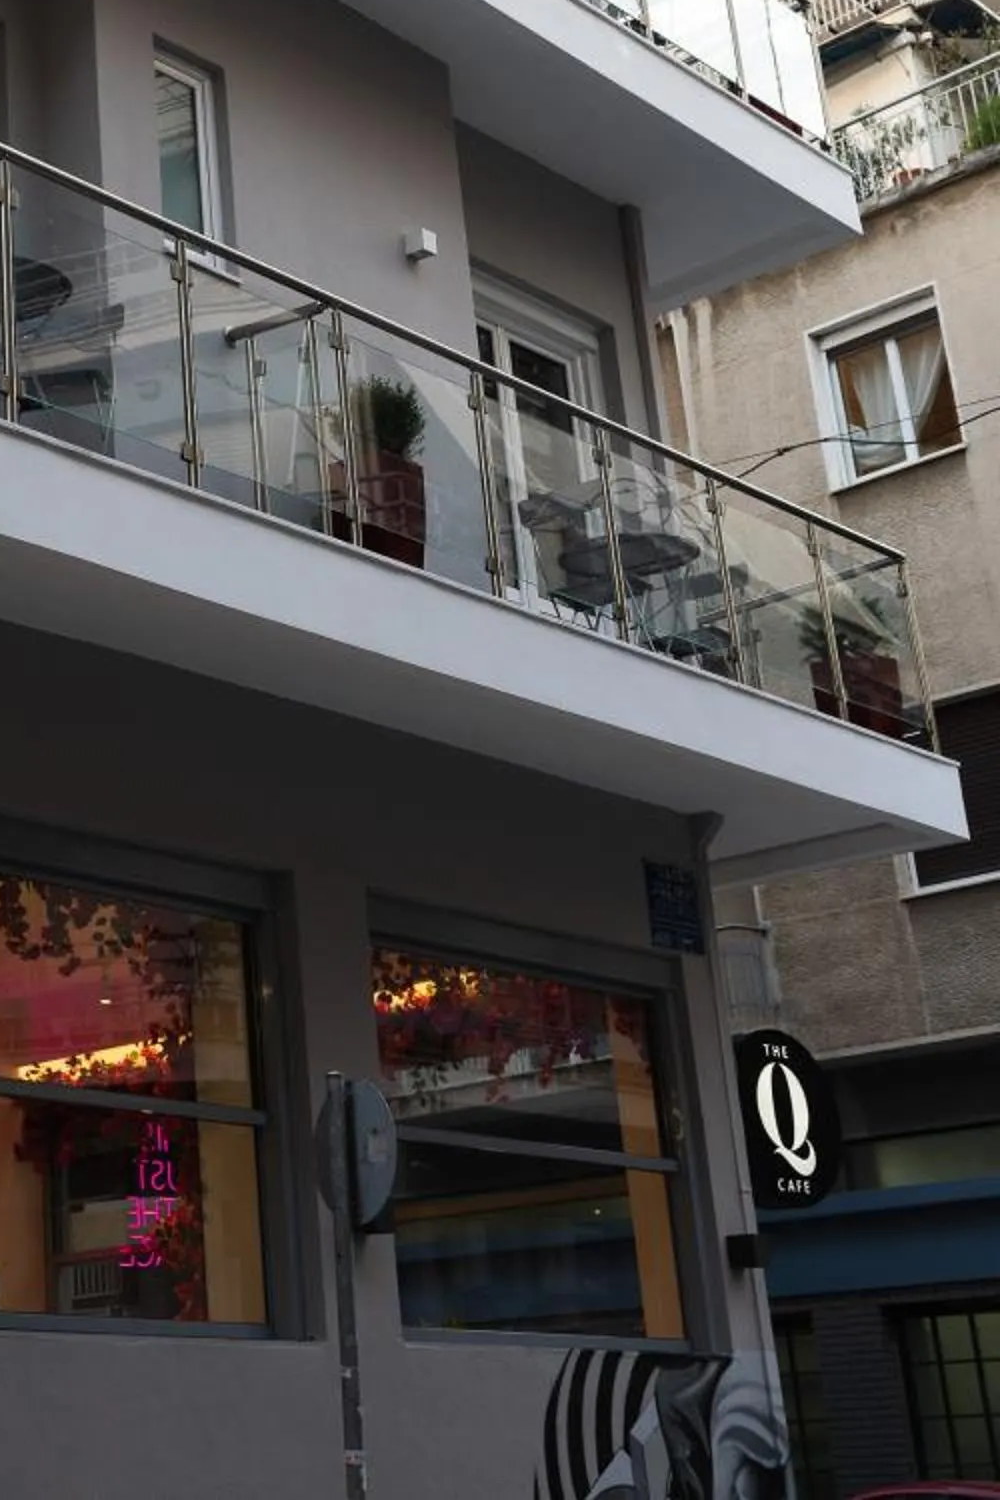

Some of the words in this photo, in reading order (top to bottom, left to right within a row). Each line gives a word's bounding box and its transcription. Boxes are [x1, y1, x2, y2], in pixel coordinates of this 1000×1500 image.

[763, 1043, 789, 1059] THE
[756, 1061, 817, 1177] Q
[777, 1177, 811, 1195] CAFE
